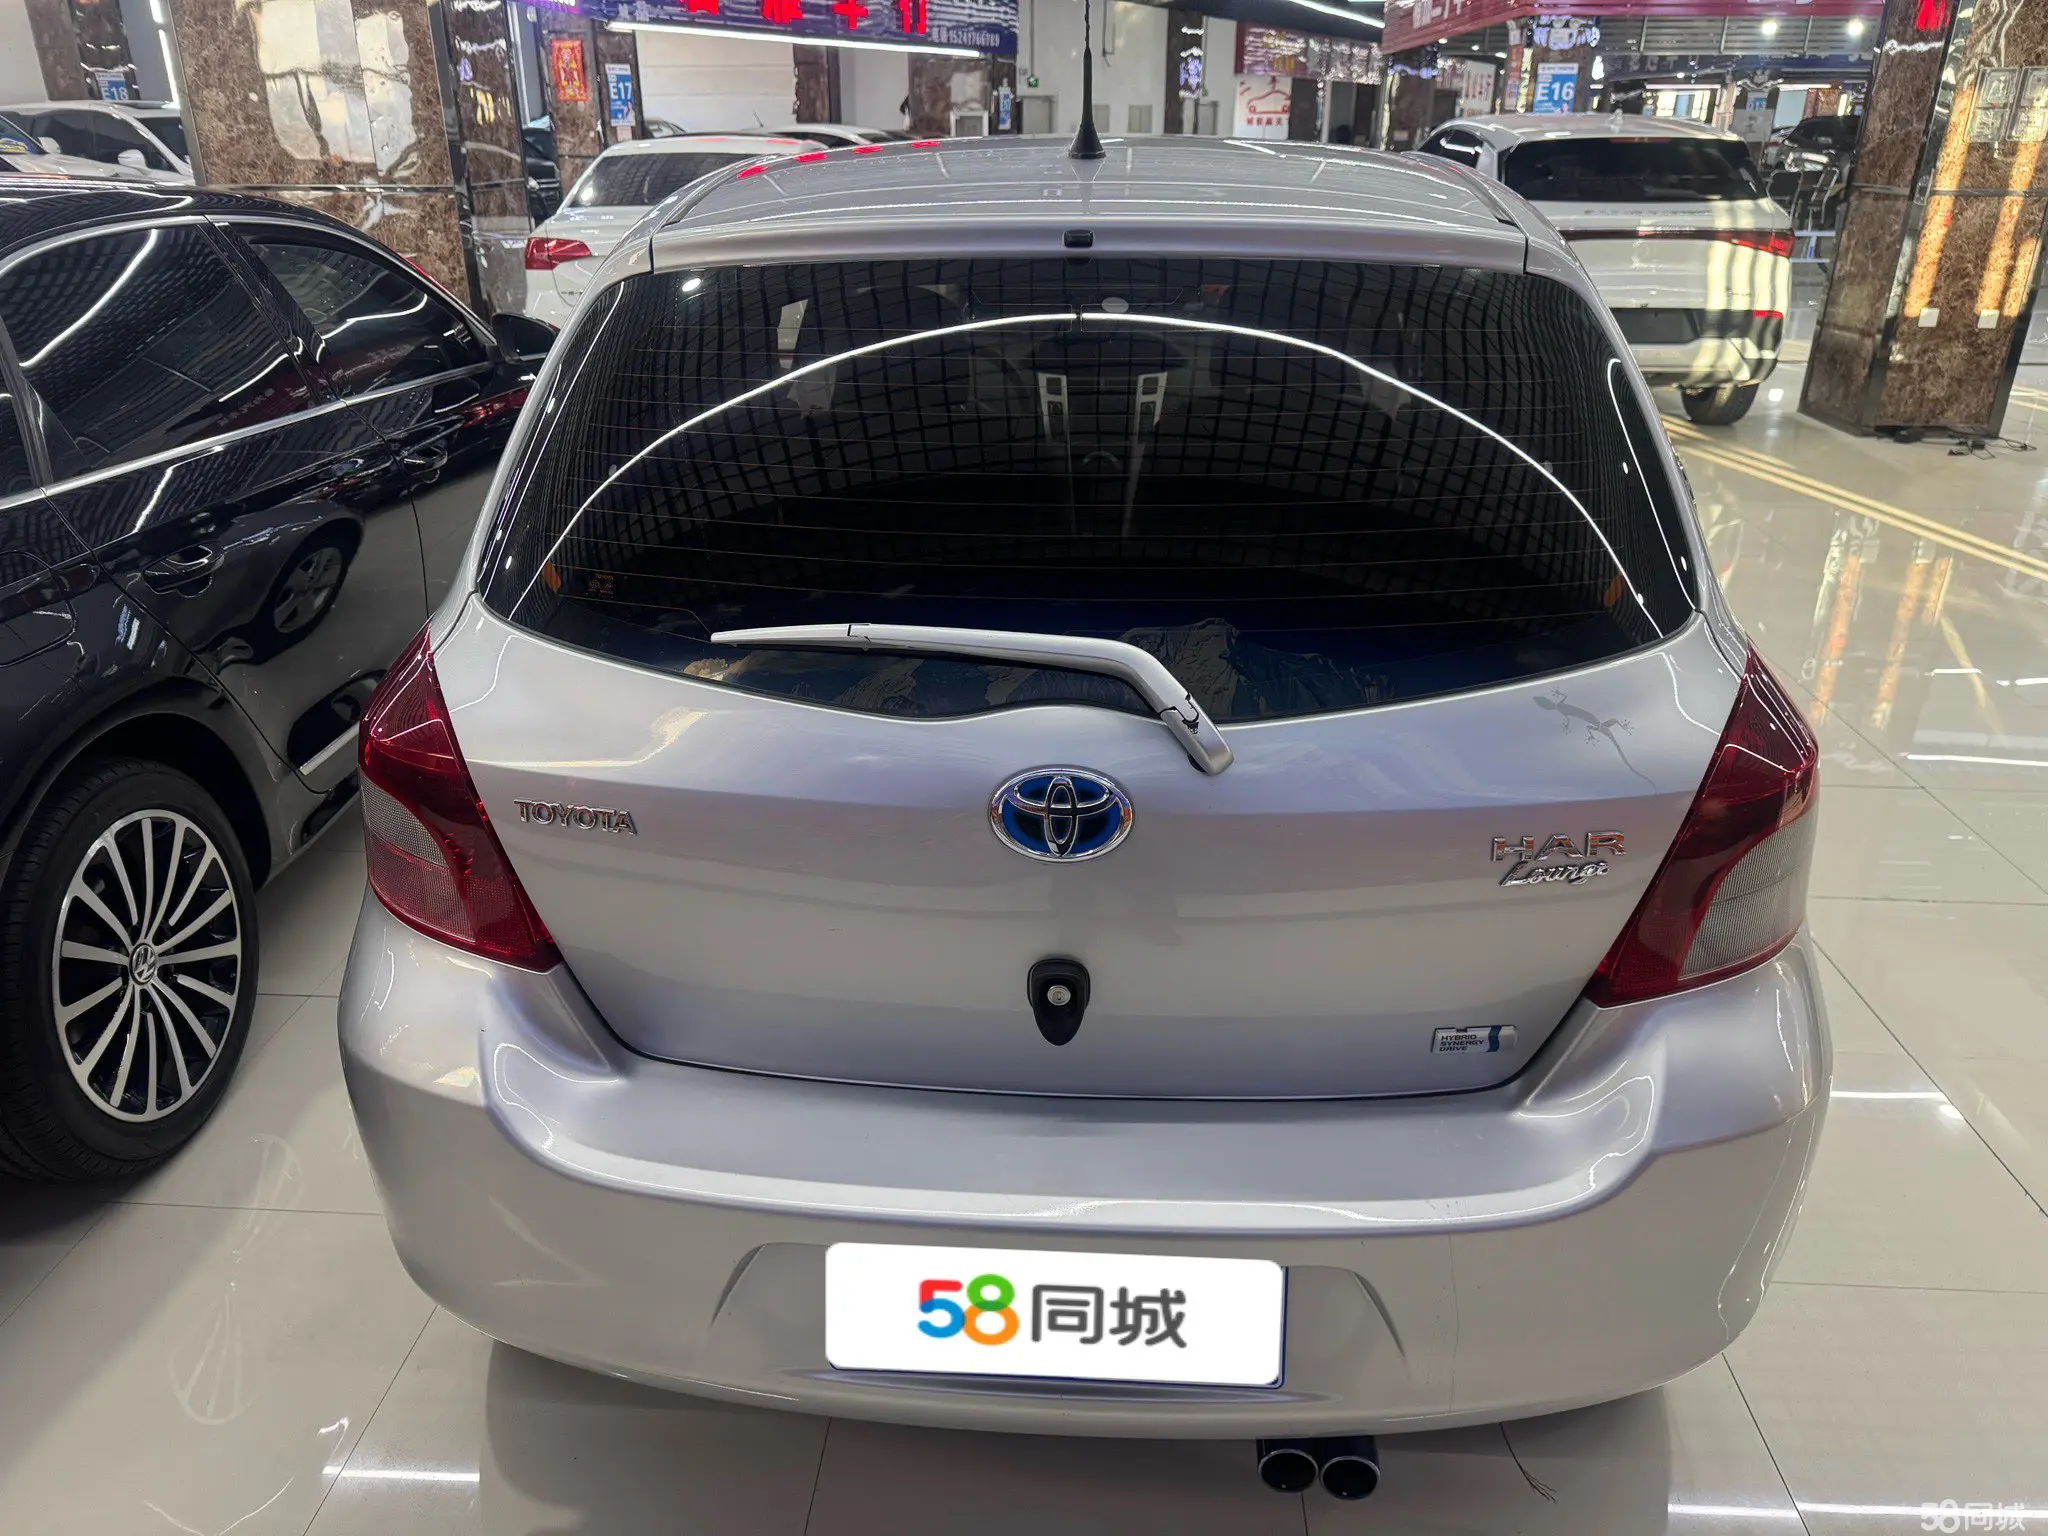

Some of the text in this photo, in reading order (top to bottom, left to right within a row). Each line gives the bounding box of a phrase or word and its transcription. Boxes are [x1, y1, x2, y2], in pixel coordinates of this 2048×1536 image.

[101, 86, 129, 101] E18
[609, 82, 632, 99] E17
[1537, 82, 1575, 101] E16
[513, 798, 638, 835] TOYOTA
[1492, 831, 1627, 862] HAR
[1500, 860, 1610, 887] Lounge
